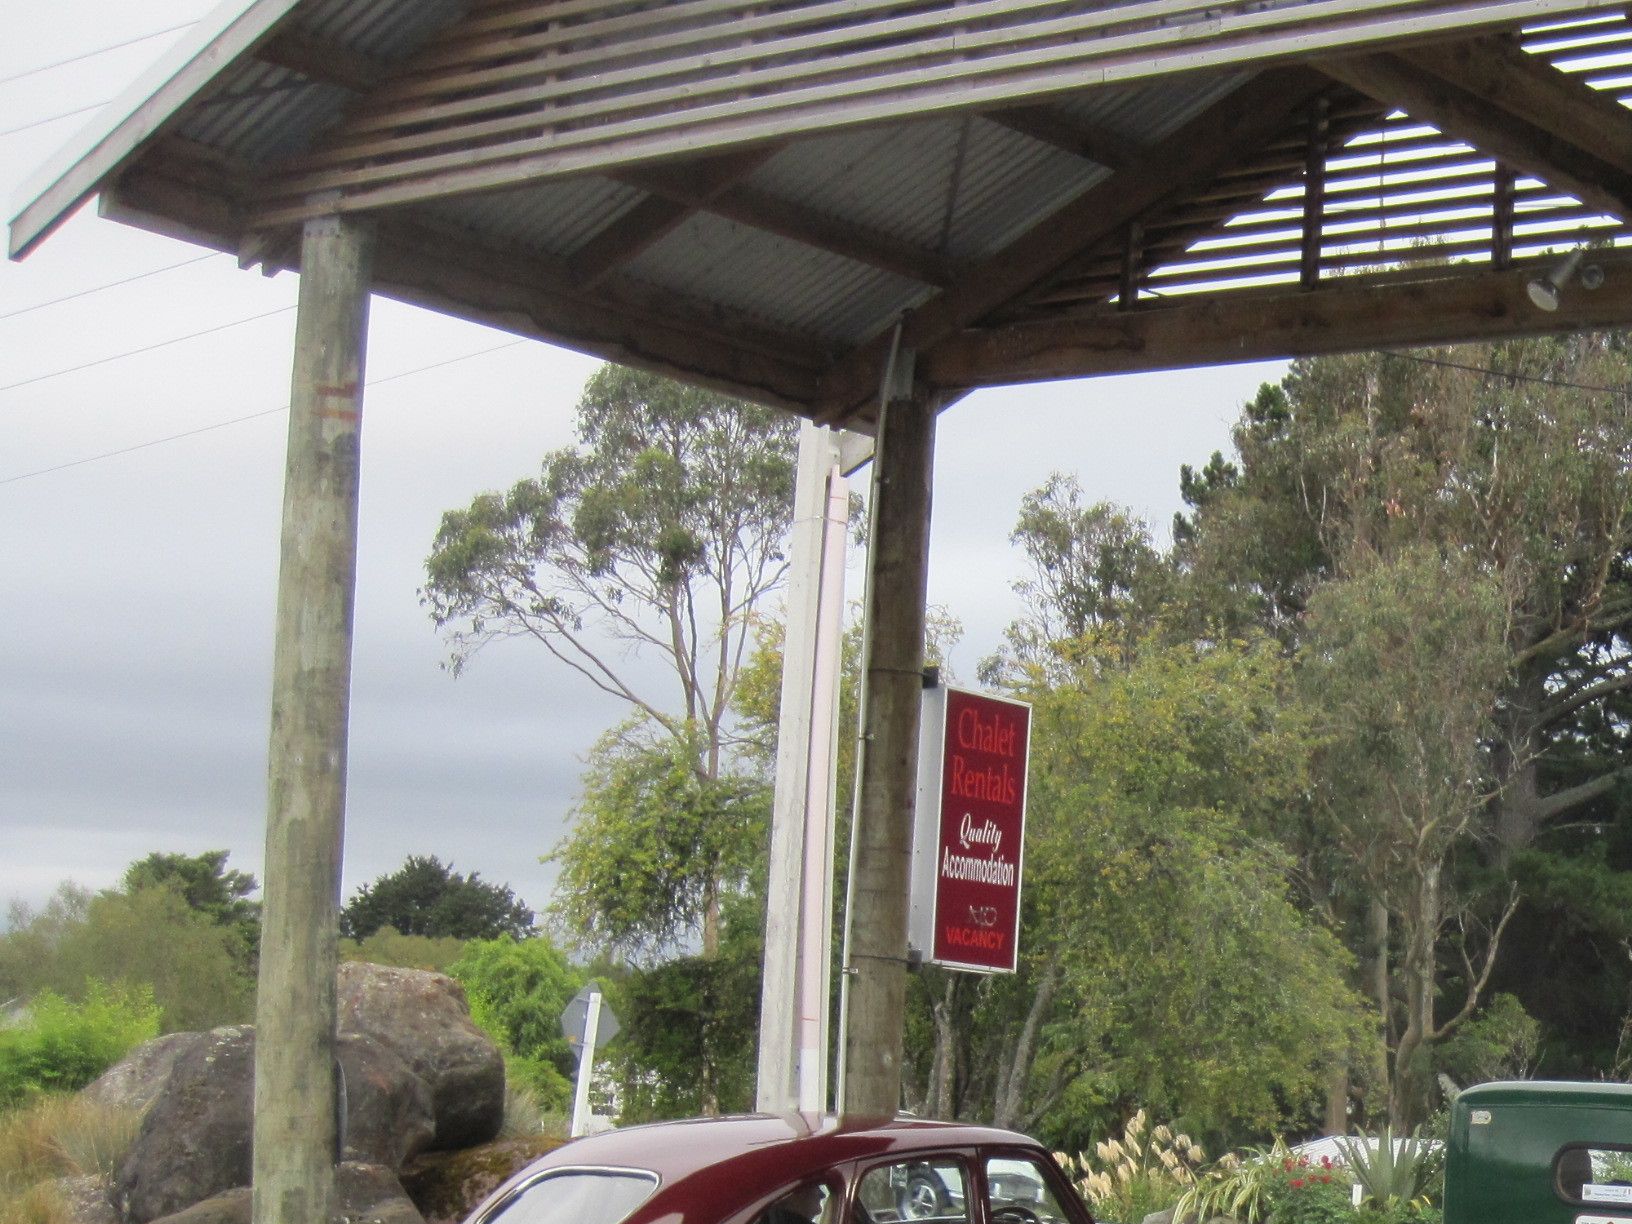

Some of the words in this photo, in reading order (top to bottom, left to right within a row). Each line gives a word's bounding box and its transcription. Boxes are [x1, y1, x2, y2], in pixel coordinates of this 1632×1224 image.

[958, 708, 1016, 757] Chalet
[951, 755, 1016, 804] Rentals
[959, 812, 1003, 853] Quality
[941, 846, 1014, 886] Accommodation
[946, 927, 1005, 949] VACANCY
